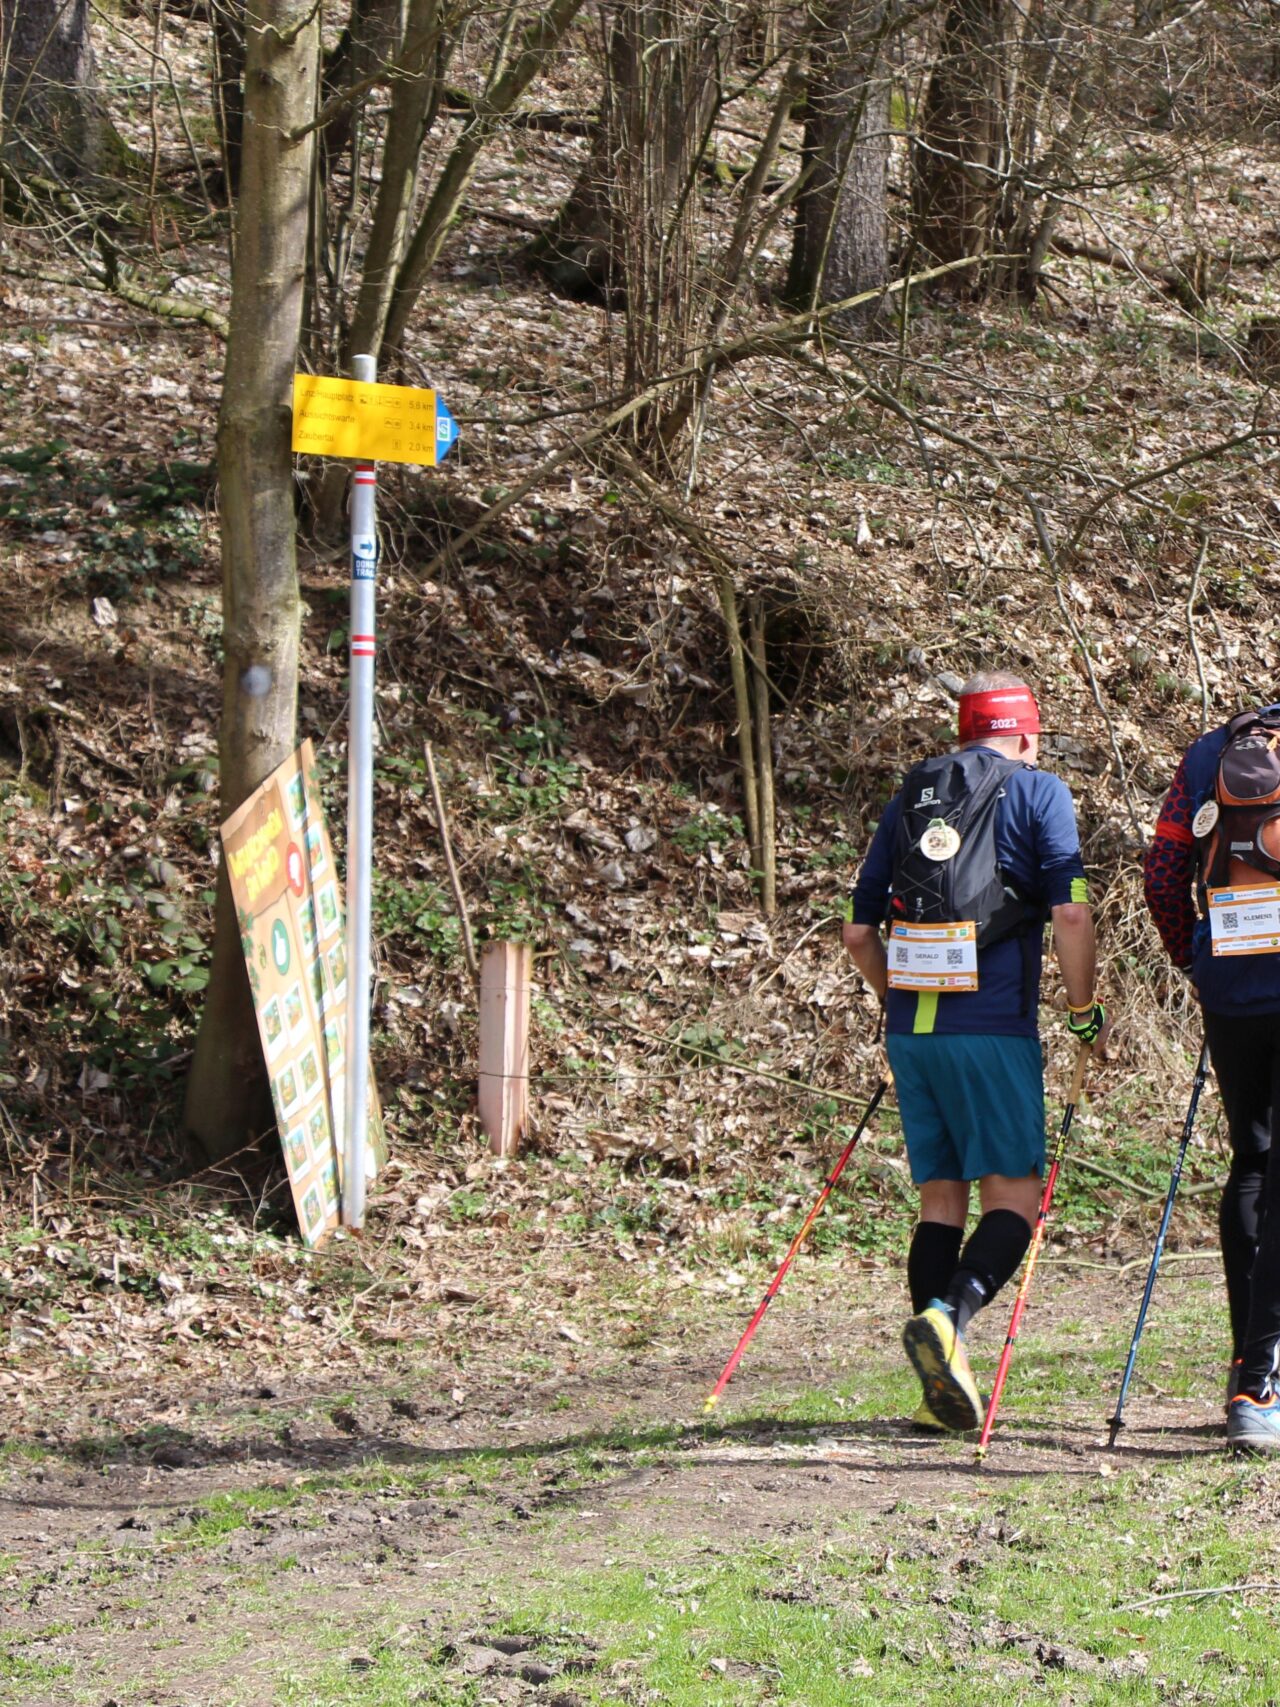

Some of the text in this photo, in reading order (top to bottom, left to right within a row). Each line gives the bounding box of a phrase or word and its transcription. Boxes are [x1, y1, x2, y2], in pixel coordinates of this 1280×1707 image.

[422, 401, 434, 411] km
[422, 423, 434, 432] km
[422, 444, 434, 453] km
[990, 717, 1018, 730] 2023
[1243, 913, 1273, 921] KLEMENS
[914, 952, 939, 960] GERALD
